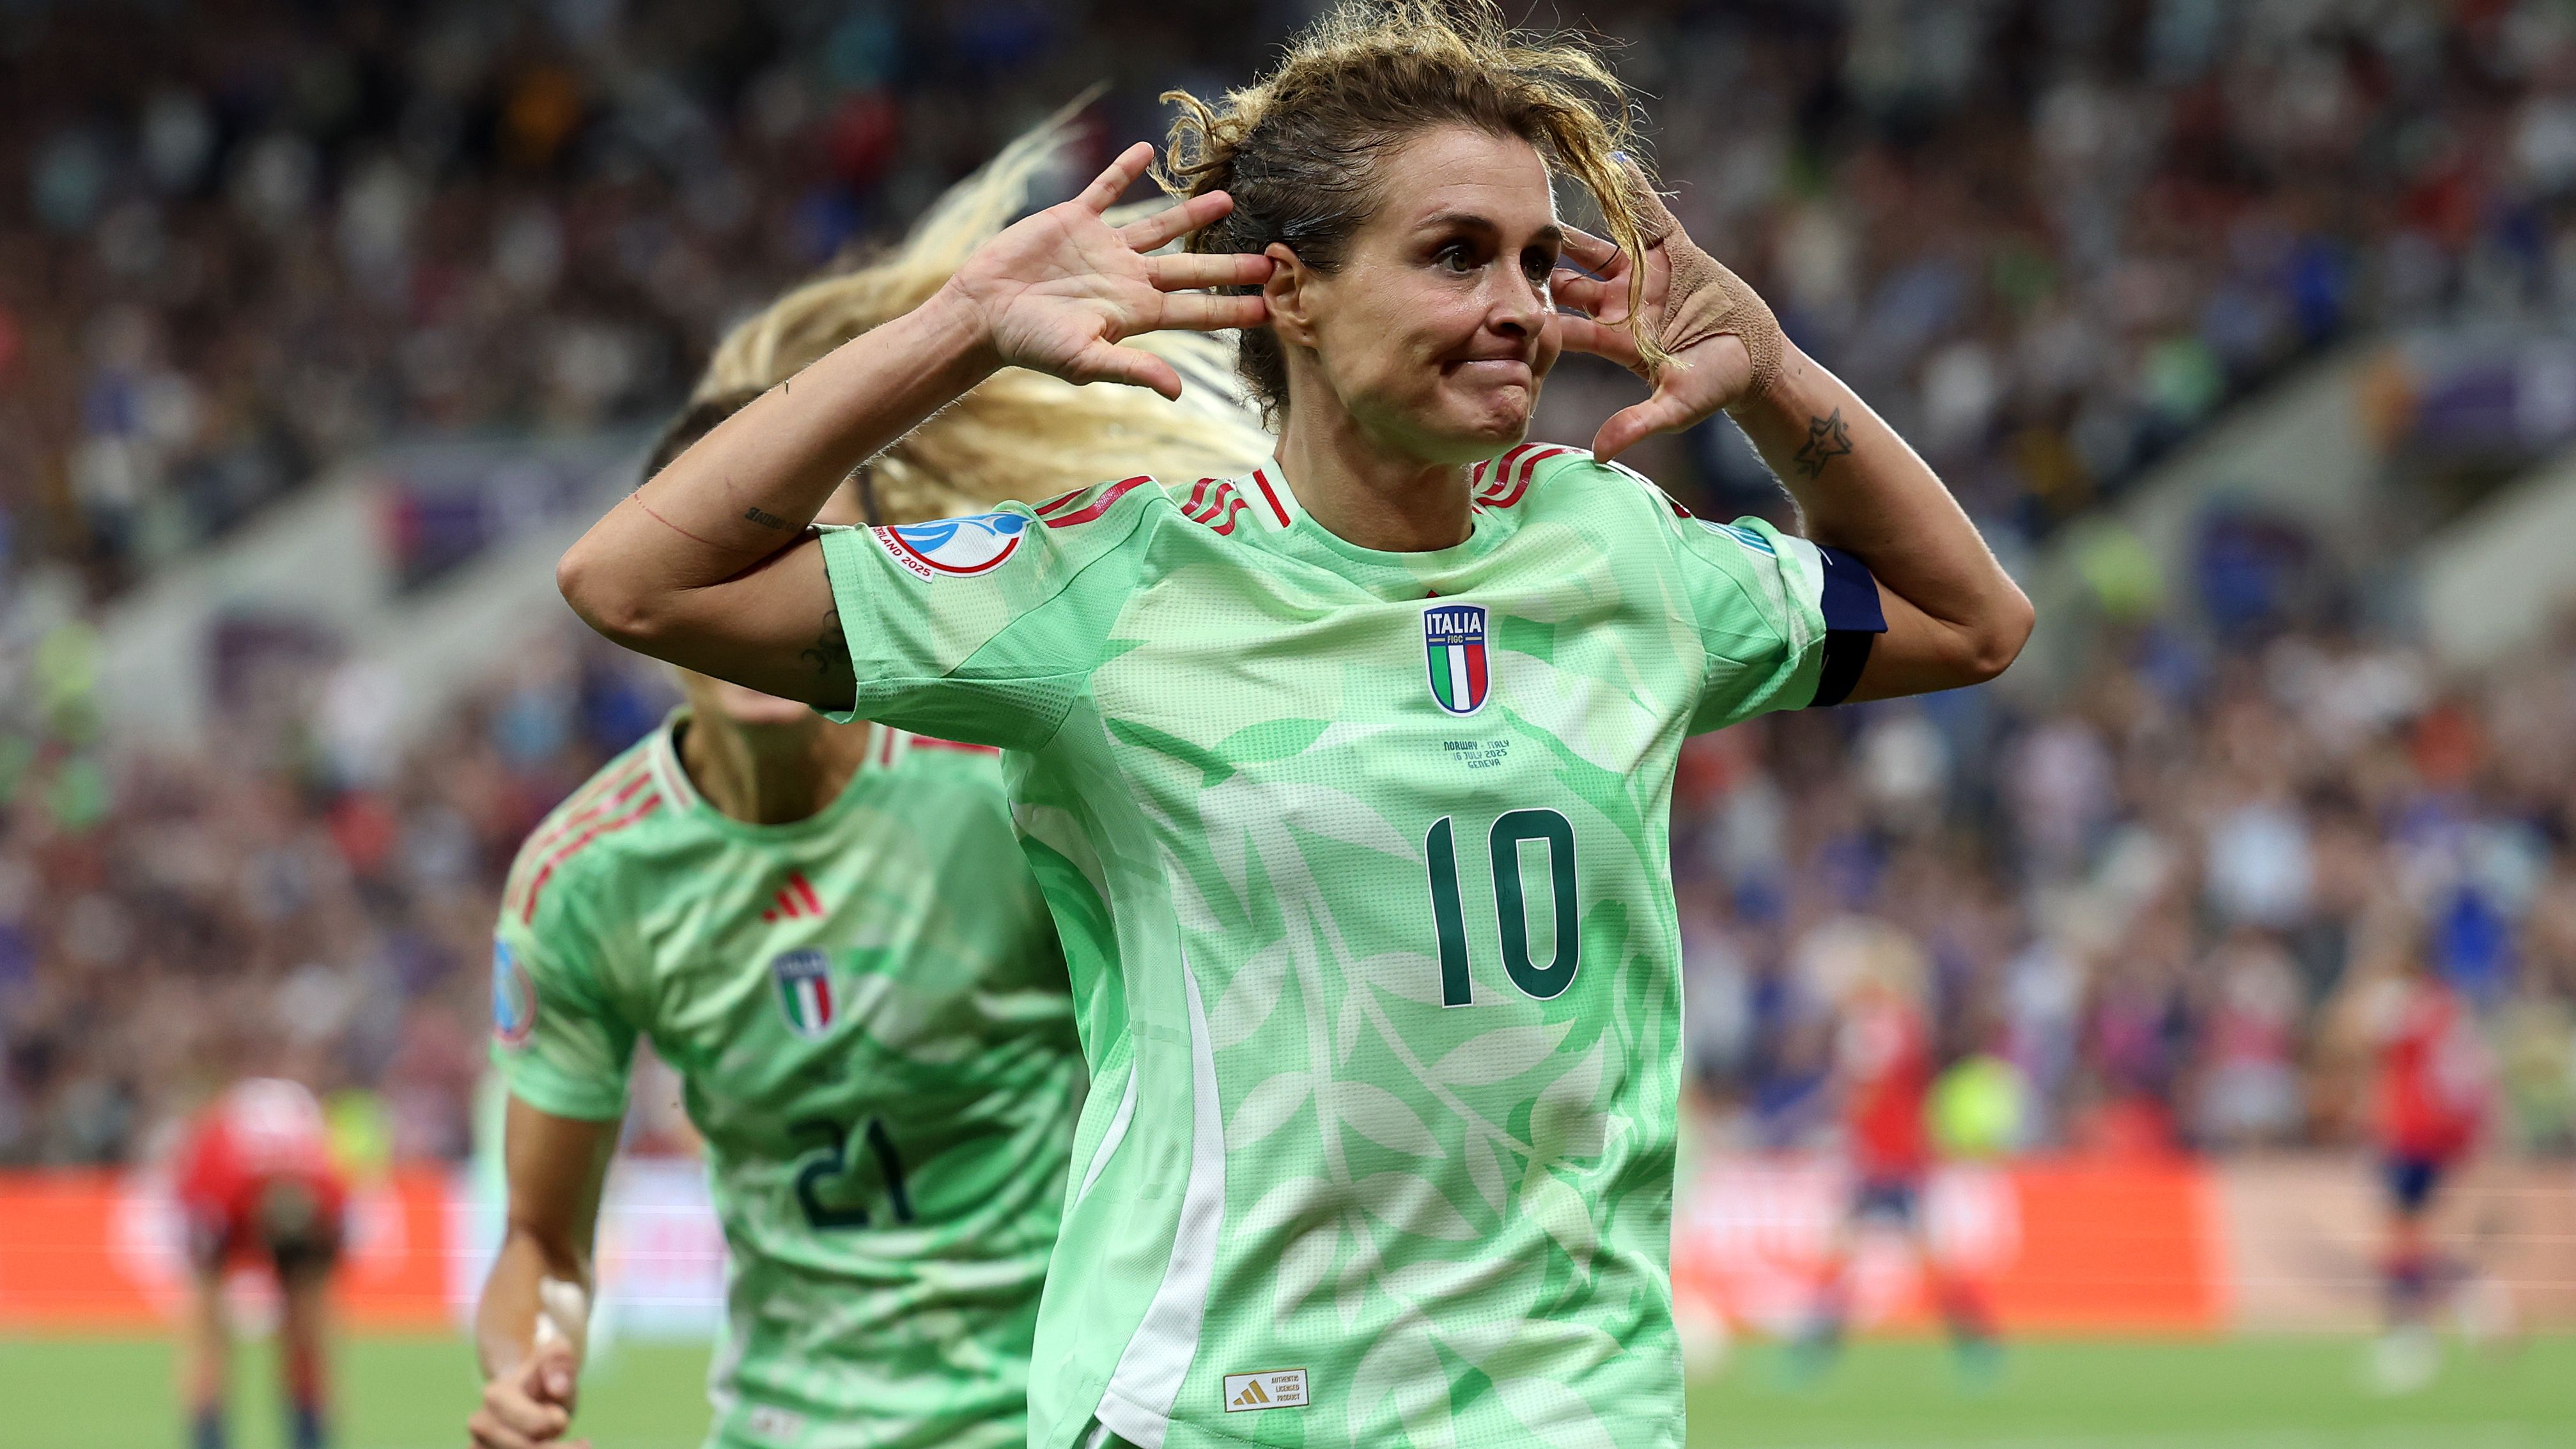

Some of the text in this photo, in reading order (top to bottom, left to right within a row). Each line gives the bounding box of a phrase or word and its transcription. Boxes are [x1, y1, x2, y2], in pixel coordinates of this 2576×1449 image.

[901, 556, 931, 577] 2025
[1427, 612, 1482, 634] ITALIA
[1447, 635, 1463, 644] FIGC
[1444, 741, 1478, 751] NORWAY
[1487, 740, 1509, 748] ITALY
[1453, 748, 1507, 761] 16 JULY 2025
[1468, 758, 1501, 768] GENEVA
[1424, 807, 1581, 1009] 10
[788, 1118, 912, 1228] 21
